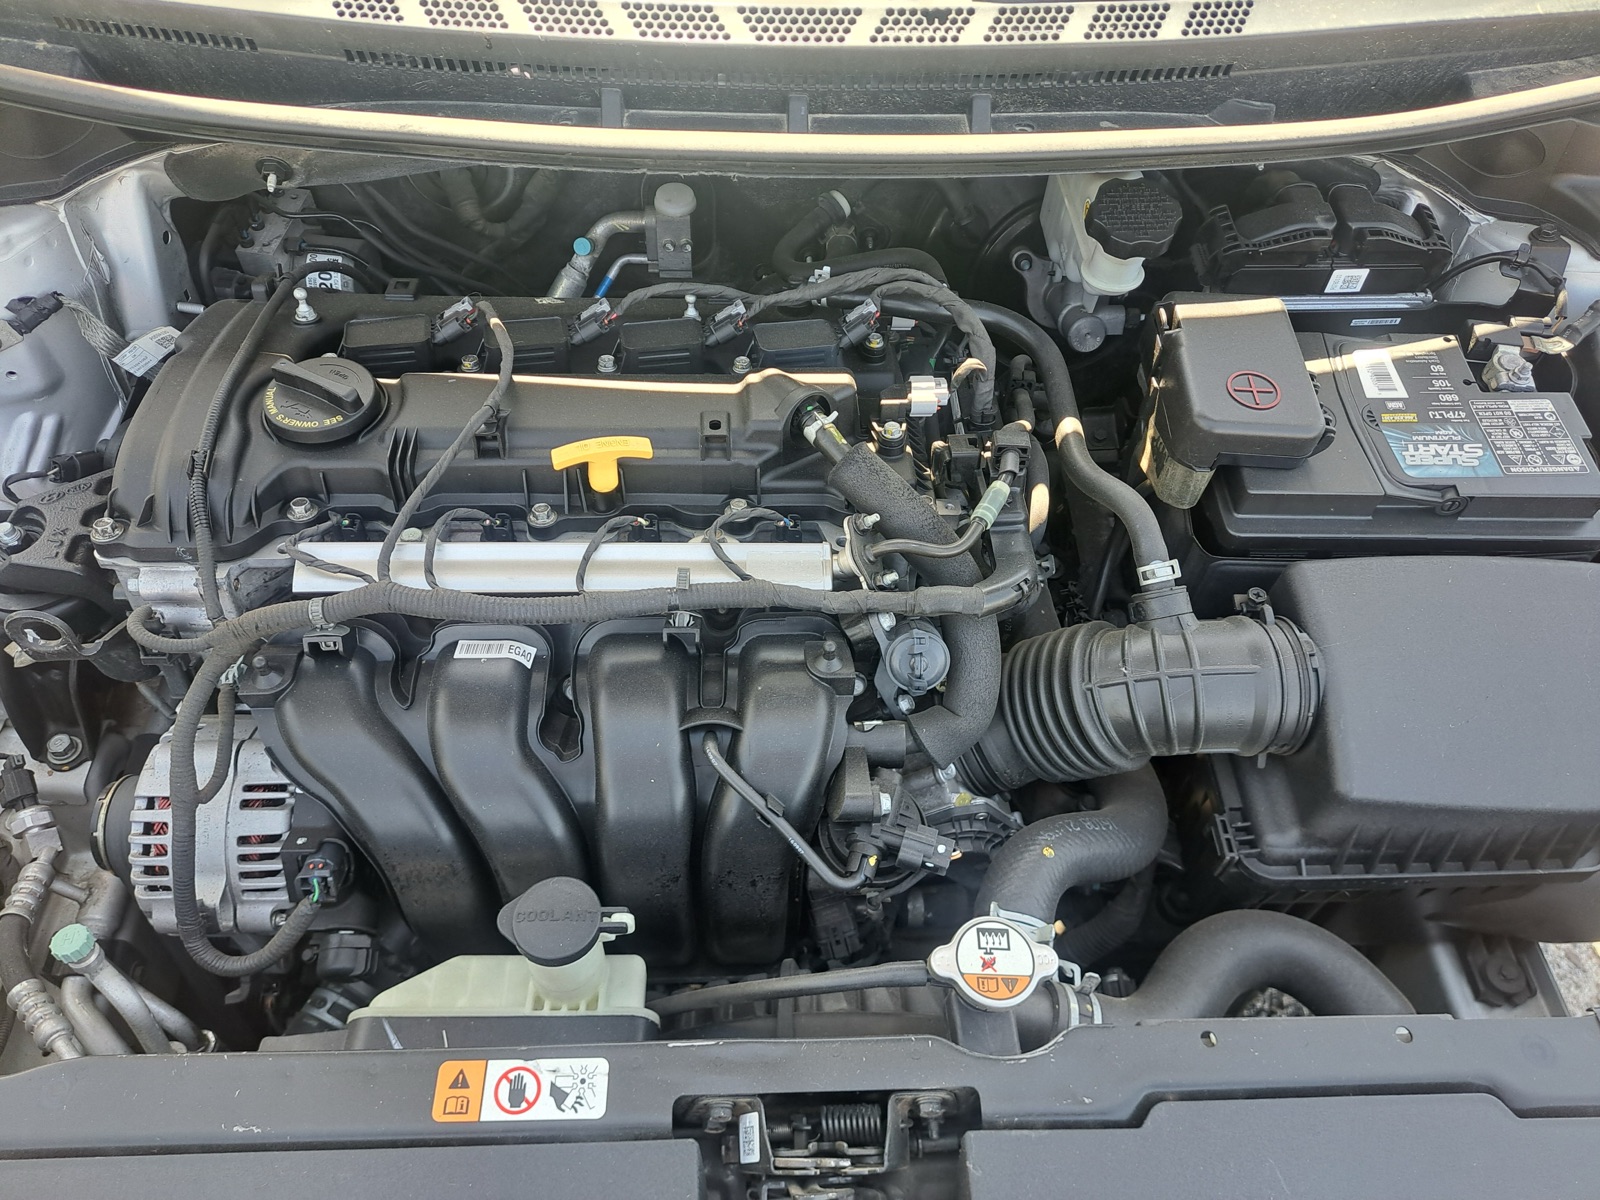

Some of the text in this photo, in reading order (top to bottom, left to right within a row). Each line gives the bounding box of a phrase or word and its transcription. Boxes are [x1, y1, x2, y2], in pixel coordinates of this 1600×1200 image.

[263, 386, 344, 429] SEE OWNER'S MANUAL
[1428, 410, 1466, 419] 47PLTJ
[574, 439, 630, 451] ENGINE OIL
[1402, 444, 1483, 455] START
[1405, 455, 1480, 466] SUPER
[515, 909, 600, 923] COOLANT
